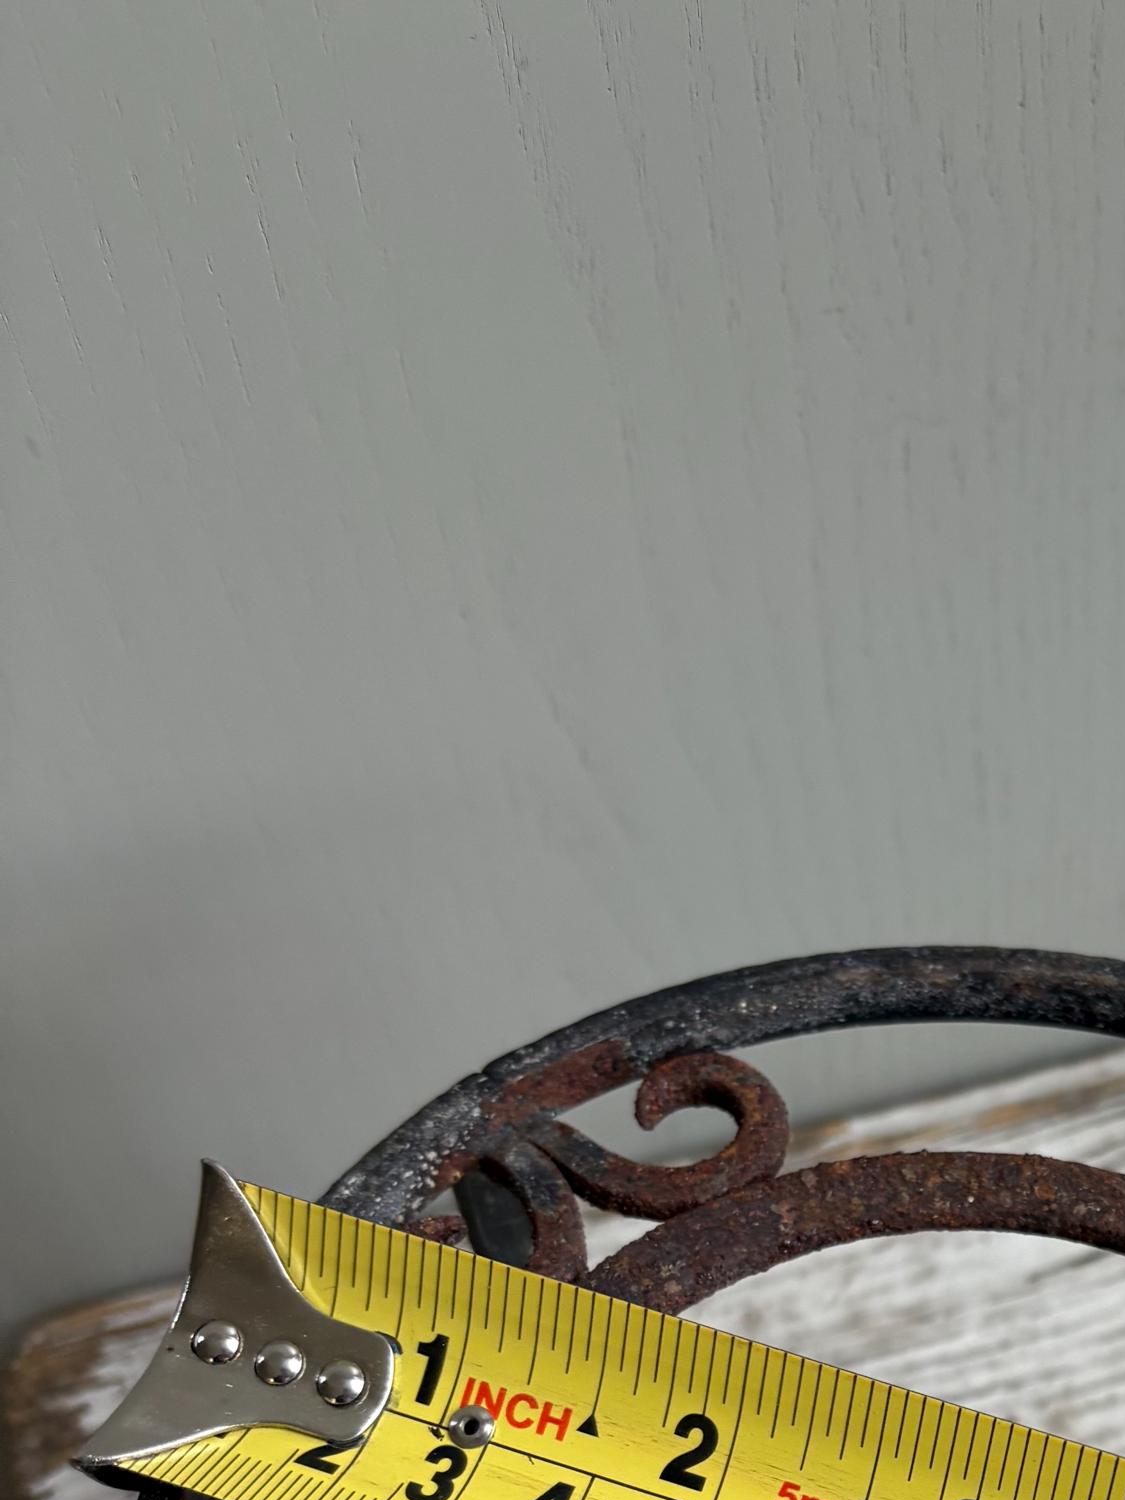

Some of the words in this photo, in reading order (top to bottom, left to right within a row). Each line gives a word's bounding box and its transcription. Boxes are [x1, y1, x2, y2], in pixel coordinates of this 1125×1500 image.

[415, 1335, 449, 1406] 1
[459, 1377, 571, 1441] INCH
[659, 1413, 719, 1492] 2
